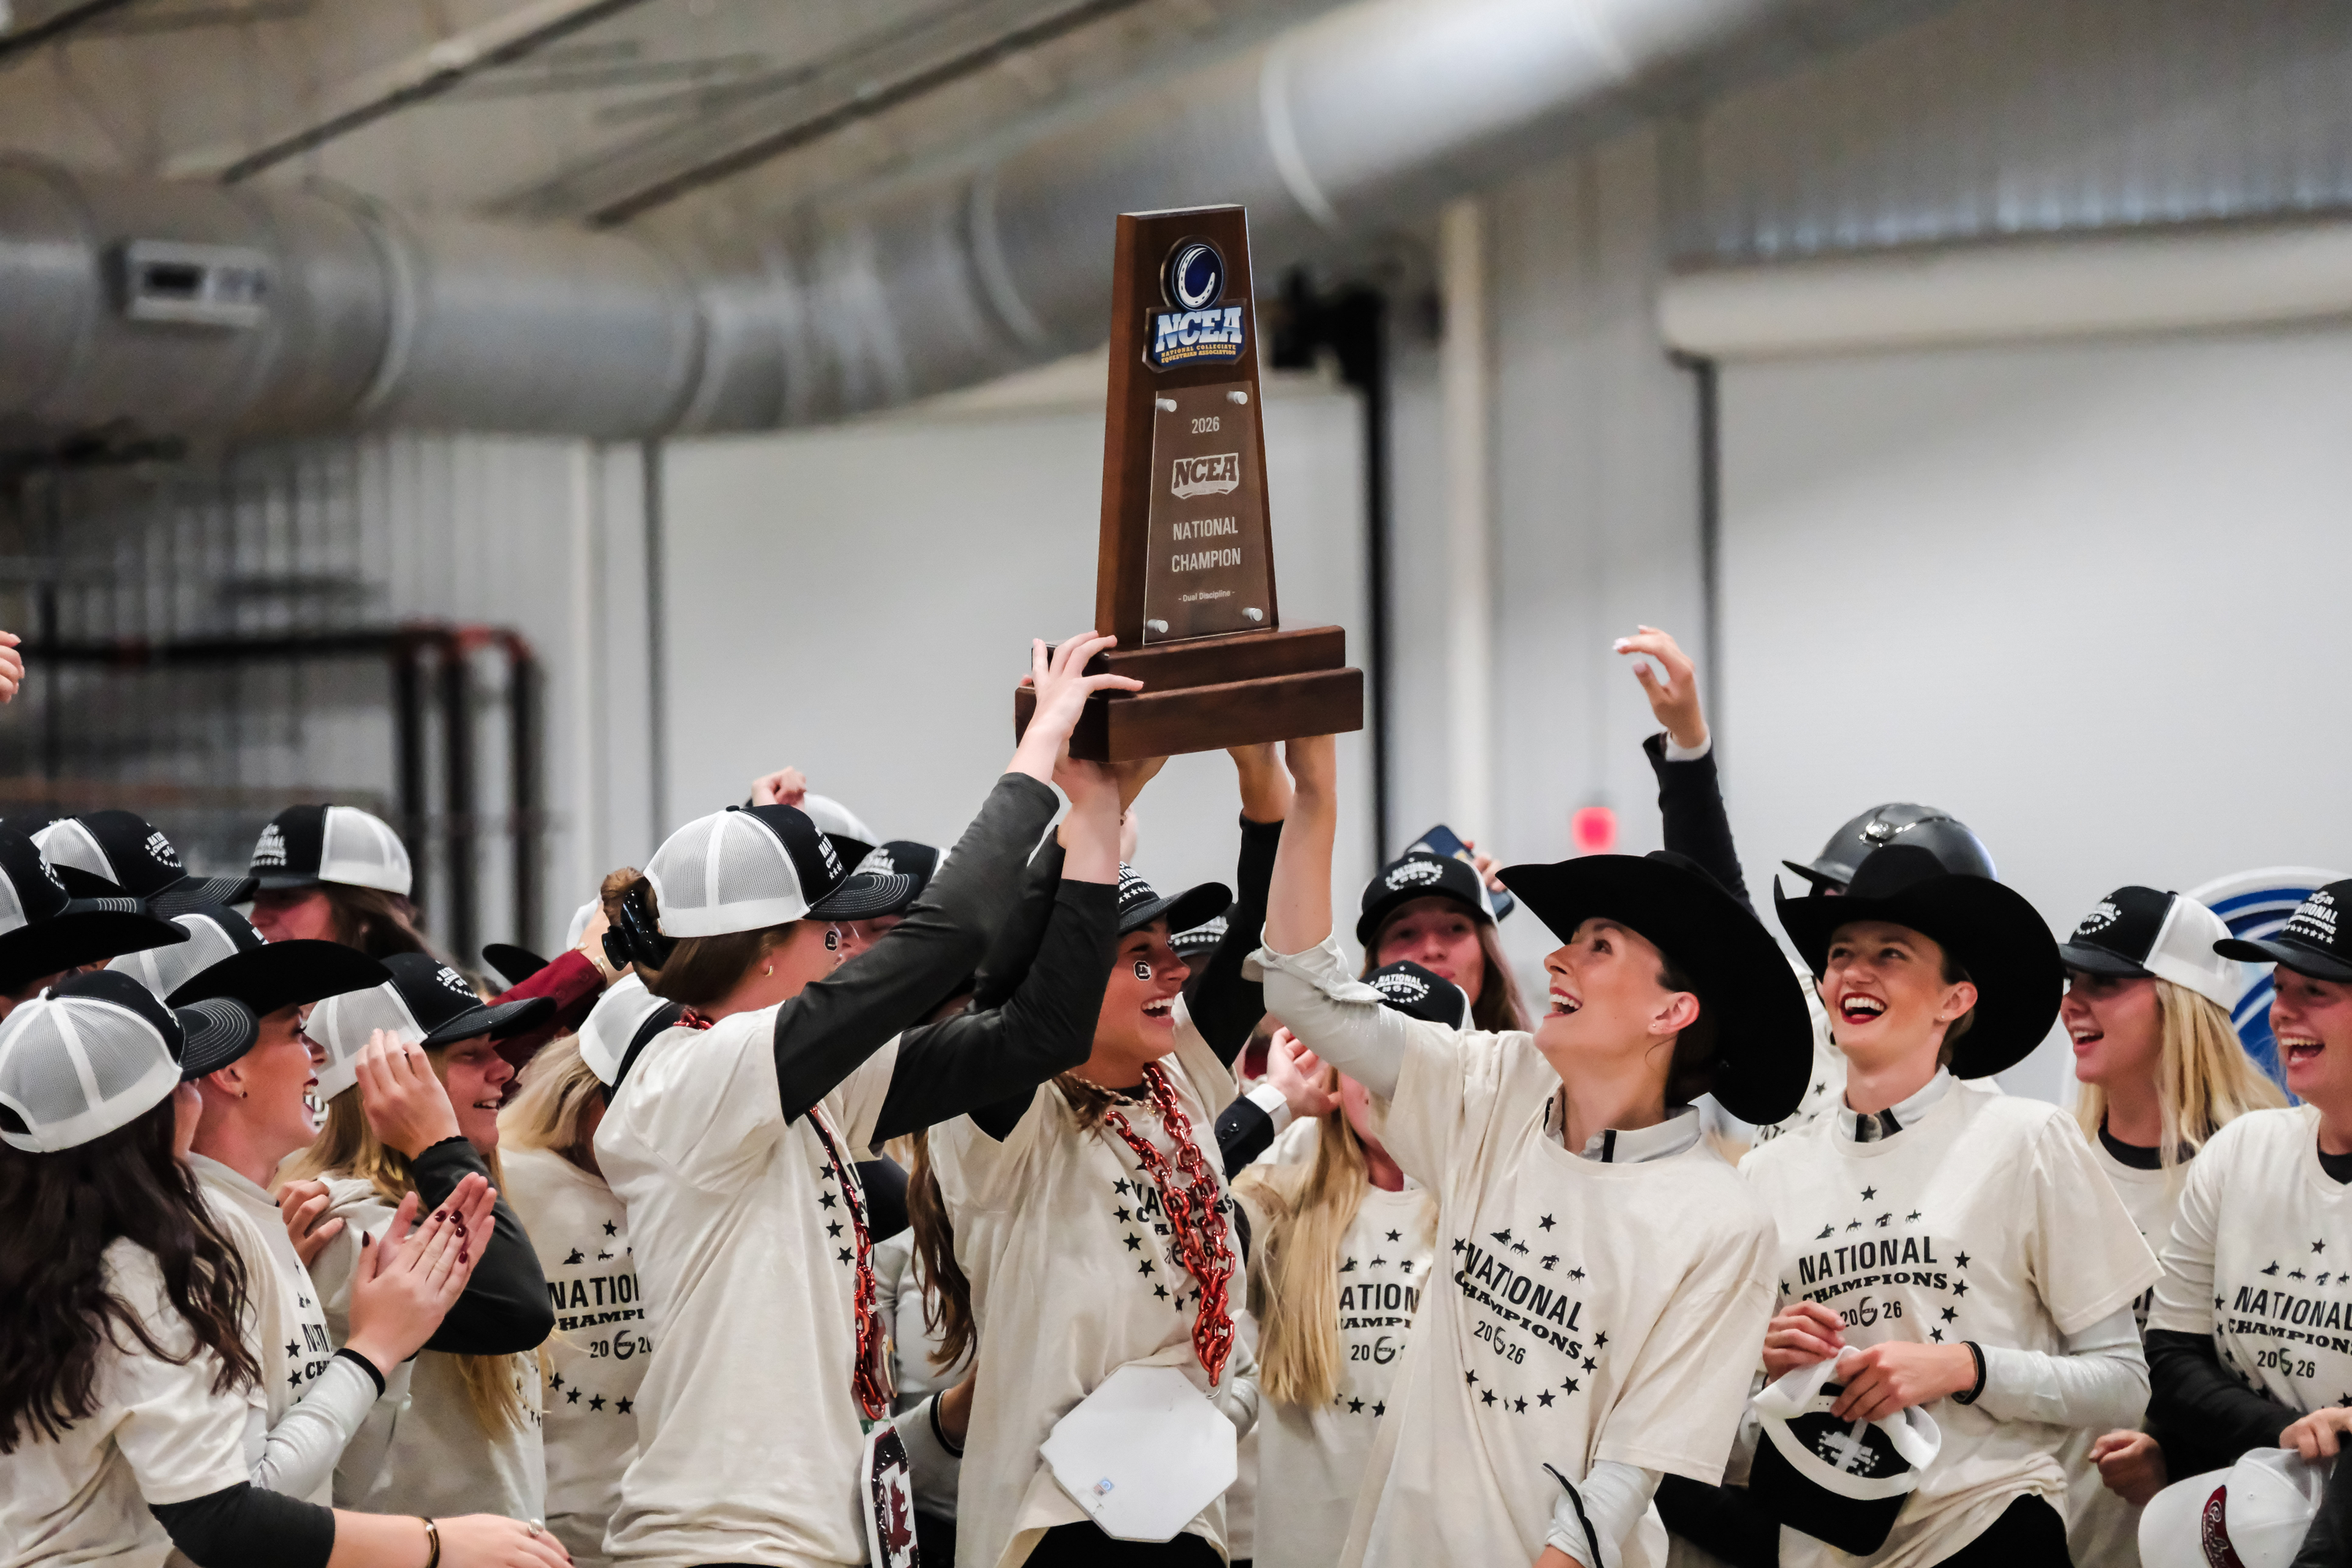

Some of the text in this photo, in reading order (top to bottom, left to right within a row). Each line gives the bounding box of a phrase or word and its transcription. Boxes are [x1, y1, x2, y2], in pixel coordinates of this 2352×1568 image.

[1156, 307, 1243, 353] NCEA
[1161, 346, 1194, 358] NATIONAL
[1161, 351, 1197, 363] EQUESTRIAN
[1192, 416, 1220, 434] 2026
[1173, 455, 1238, 489] NCEA
[1173, 517, 1239, 541] NATIONAL
[1171, 547, 1241, 573] CHAMPION
[1182, 593, 1198, 602] Dual
[1199, 590, 1231, 600] Discipline
[1378, 973, 1421, 985] NATIONAL
[1798, 1236, 1938, 1286] NATIONAL
[1465, 1242, 1582, 1333] NATIONAL
[1454, 1269, 1583, 1360] CHAMPIONS
[2234, 1286, 2352, 1331] NATIONAL
[2228, 1318, 2352, 1356] CHAMPION
